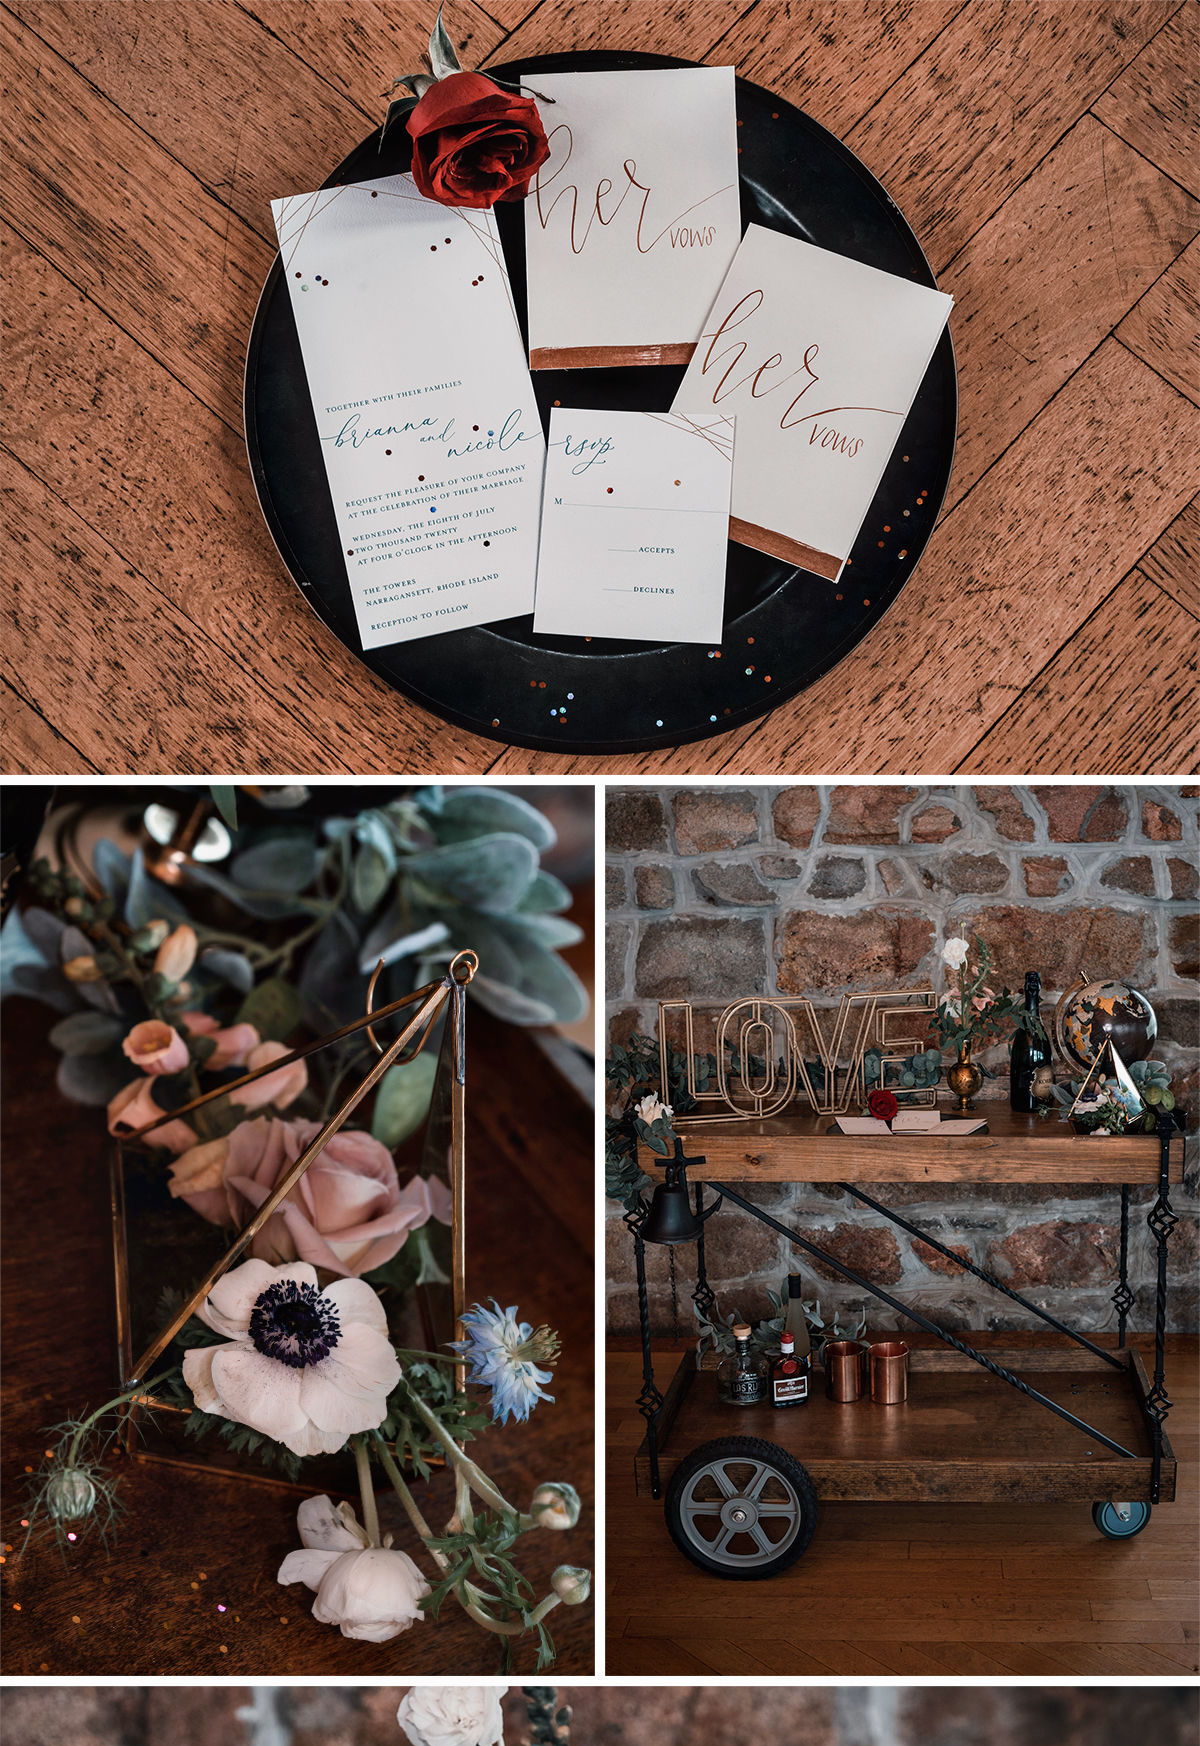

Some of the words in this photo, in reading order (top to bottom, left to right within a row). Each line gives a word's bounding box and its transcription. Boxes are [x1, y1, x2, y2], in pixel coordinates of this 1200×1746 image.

[527, 124, 735, 254] her
[702, 289, 904, 429] her
[325, 399, 370, 414] TOGETHER
[372, 393, 394, 404] WITH
[396, 388, 422, 399] THEIR
[424, 380, 463, 393] FAMILIES
[320, 413, 439, 448] brianna
[419, 418, 455, 443] and
[447, 408, 543, 458] nicole
[549, 434, 615, 475] rsvp
[345, 494, 383, 508] REQUEST
[386, 490, 402, 500] THE
[404, 481, 446, 495] PLEASURE
[447, 478, 459, 486] OF
[460, 473, 484, 483] YOUR
[486, 464, 527, 478] COMPANY
[347, 512, 360, 520] AT
[360, 507, 378, 517] THE
[380, 495, 438, 513] CELEBRATION
[439, 491, 451, 500] OF
[453, 486, 479, 496] THEIR
[481, 476, 525, 491] MARRIAGE
[352, 526, 406, 543] WEDNESDAY,
[408, 521, 425, 531] THE
[427, 514, 460, 527] EIGHTH
[462, 511, 473, 519] OF
[475, 506, 497, 517] JULY
[354, 545, 374, 554] TWO
[376, 534, 422, 550] THOUSAND
[424, 526, 459, 539] TWENTY
[357, 558, 369, 566] AT
[370, 552, 393, 563] FOUR
[395, 544, 433, 558] O'CLOCK
[435, 541, 446, 549] IN
[448, 537, 466, 546] THE
[467, 525, 519, 542] AFTERNOON
[362, 586, 381, 595] THE
[383, 578, 417, 591] TOWERS
[366, 587, 434, 607] NARRAGANSETT,
[437, 580, 466, 591] RHODE
[468, 572, 500, 585] ISLAND
[633, 586, 675, 594] DECLINES
[370, 614, 418, 631] RECEPTION
[420, 611, 433, 619] TO
[435, 603, 470, 616] FOLLOW
[658, 991, 938, 1125] LOVE
